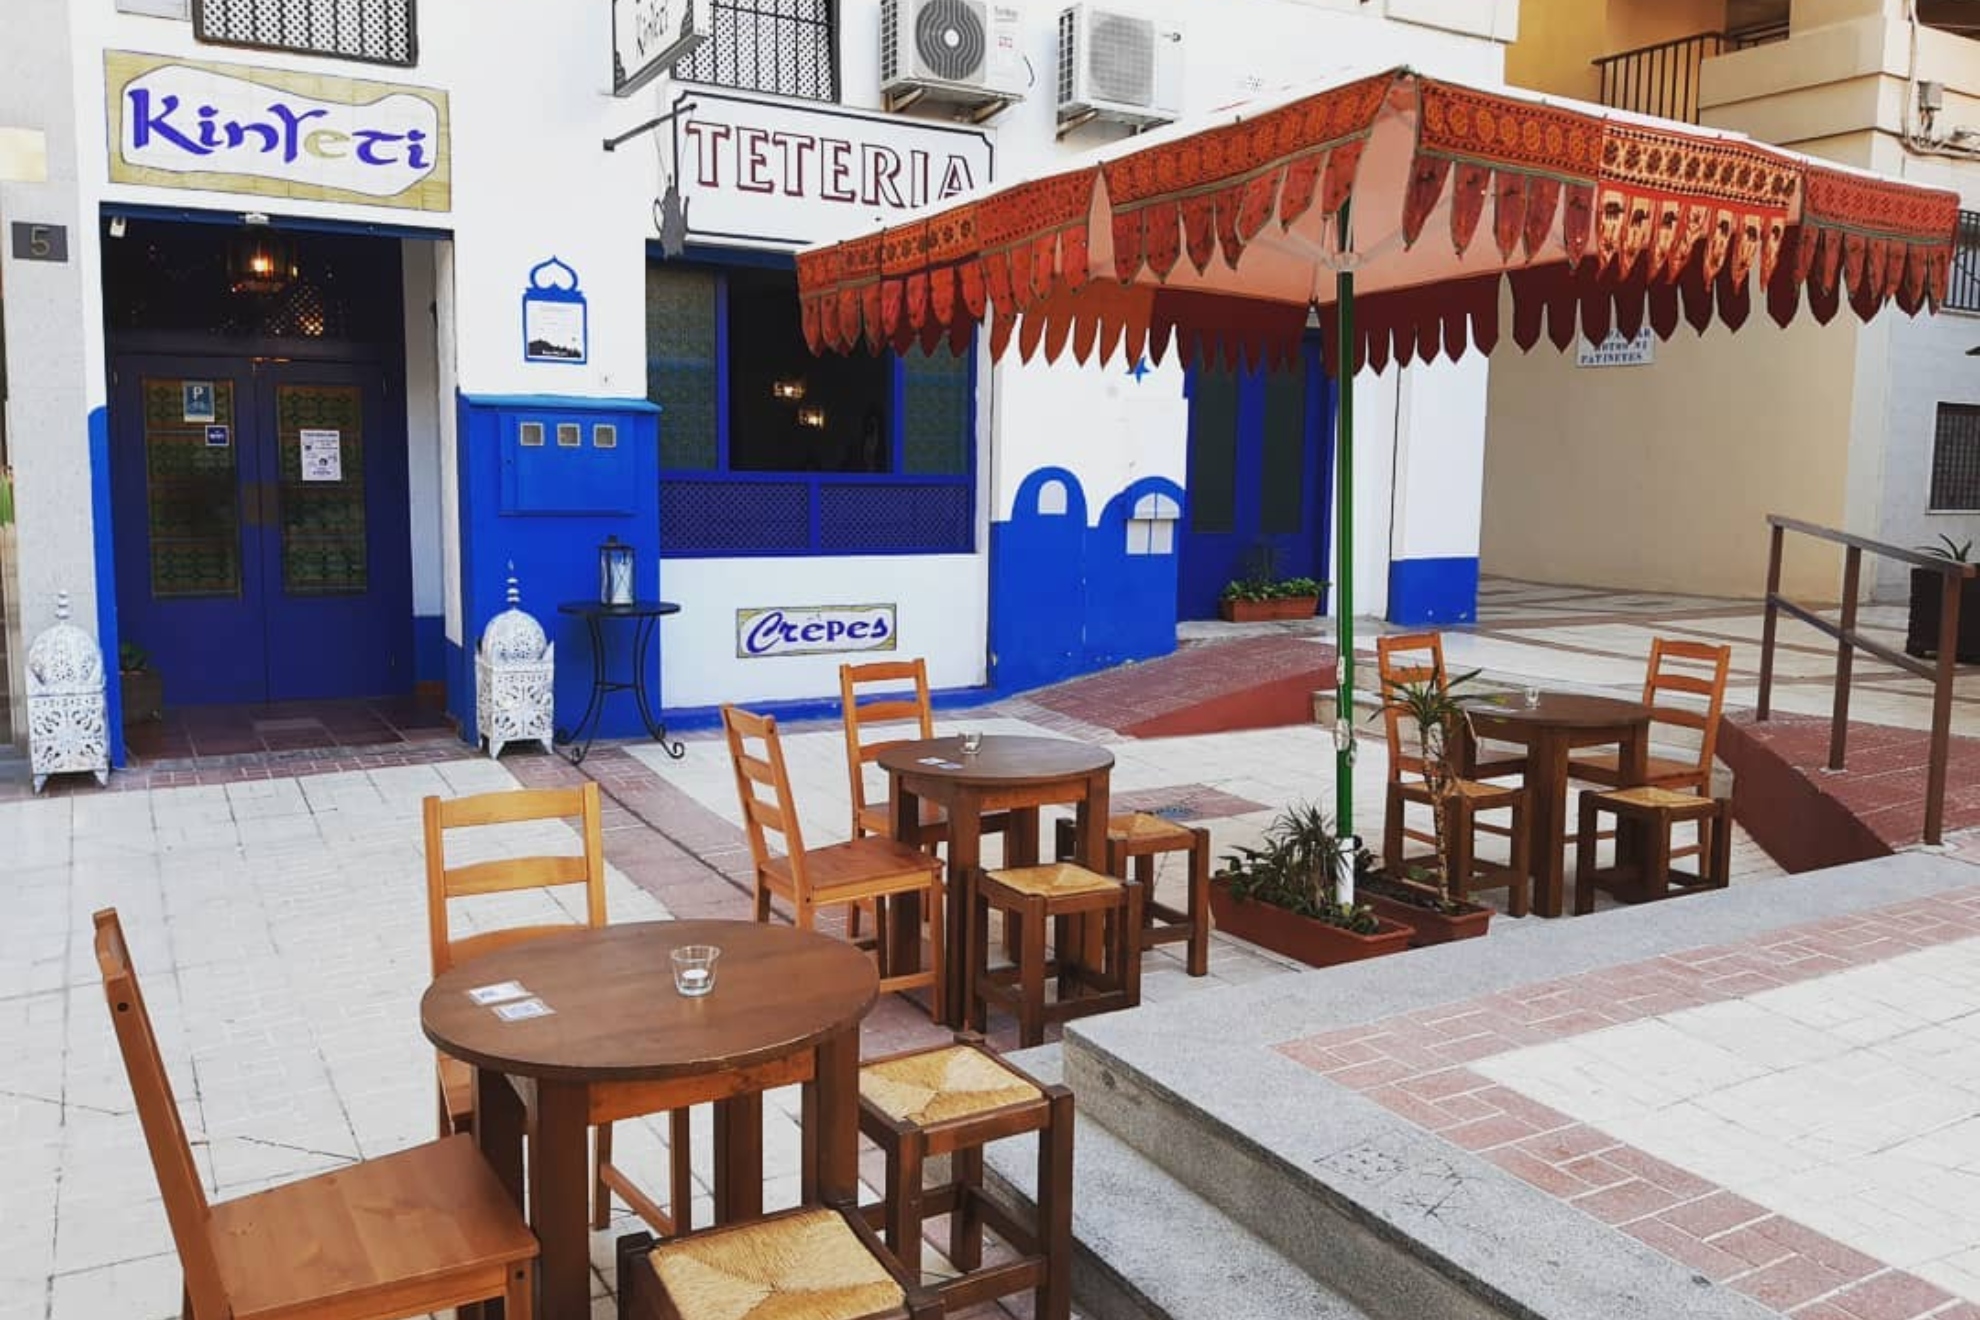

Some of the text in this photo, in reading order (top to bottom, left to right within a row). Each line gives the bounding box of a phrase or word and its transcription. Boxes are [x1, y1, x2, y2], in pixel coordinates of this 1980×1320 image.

[685, 120, 975, 208] TETERIA
[31, 226, 50, 255] 5
[194, 386, 204, 400] P
